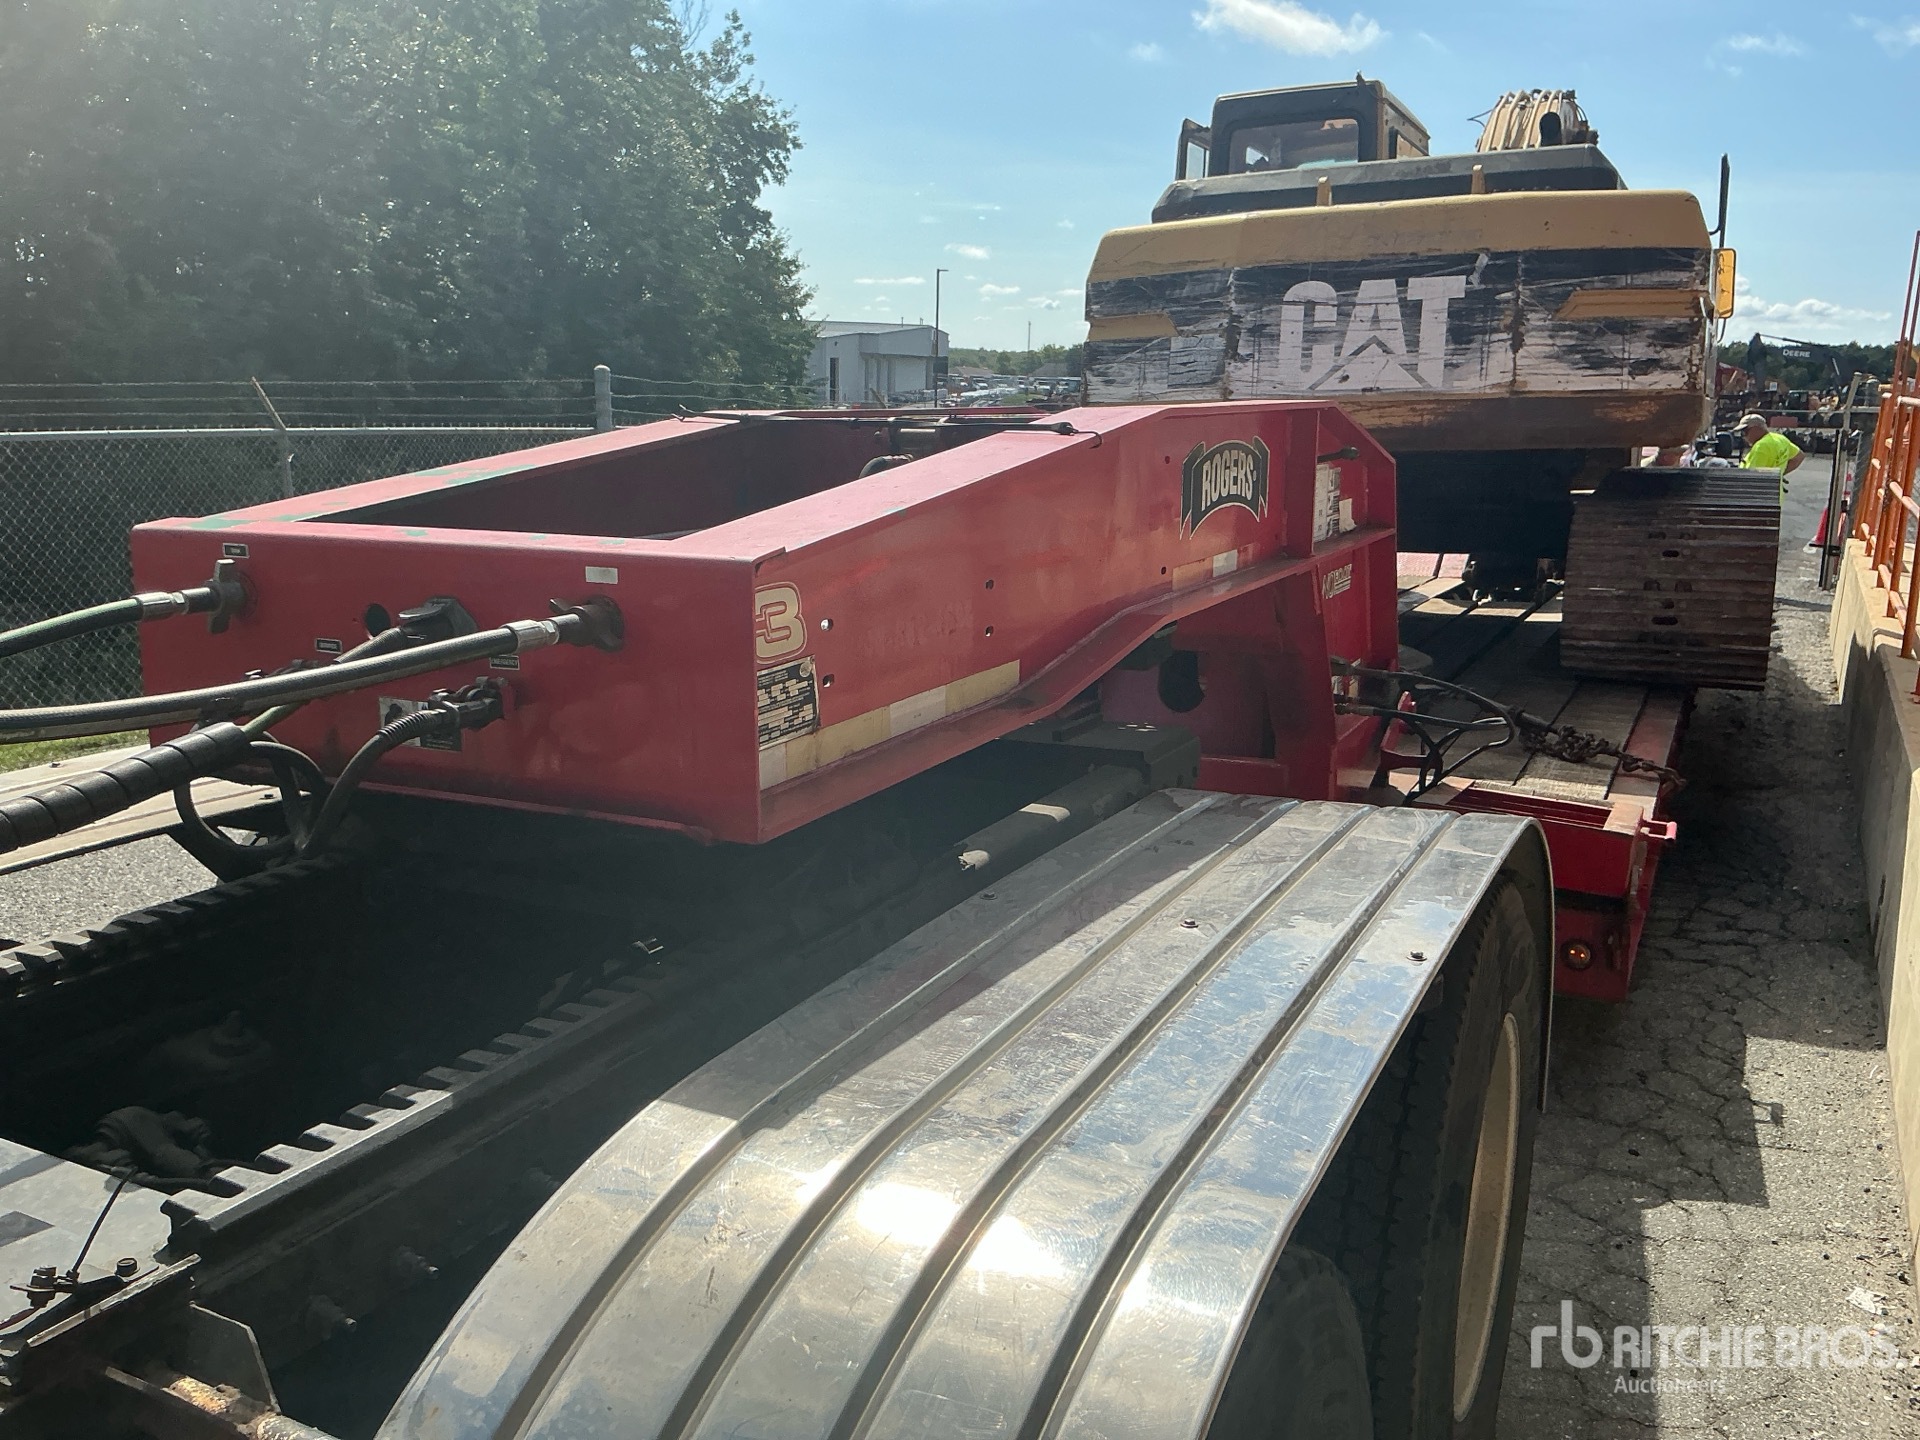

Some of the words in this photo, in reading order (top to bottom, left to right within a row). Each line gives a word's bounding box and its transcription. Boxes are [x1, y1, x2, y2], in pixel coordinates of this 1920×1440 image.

[1279, 275, 1467, 389] CAT
[1783, 349, 1810, 358] DEERE
[1202, 450, 1254, 511] ROGERS
[754, 582, 808, 665] 3
